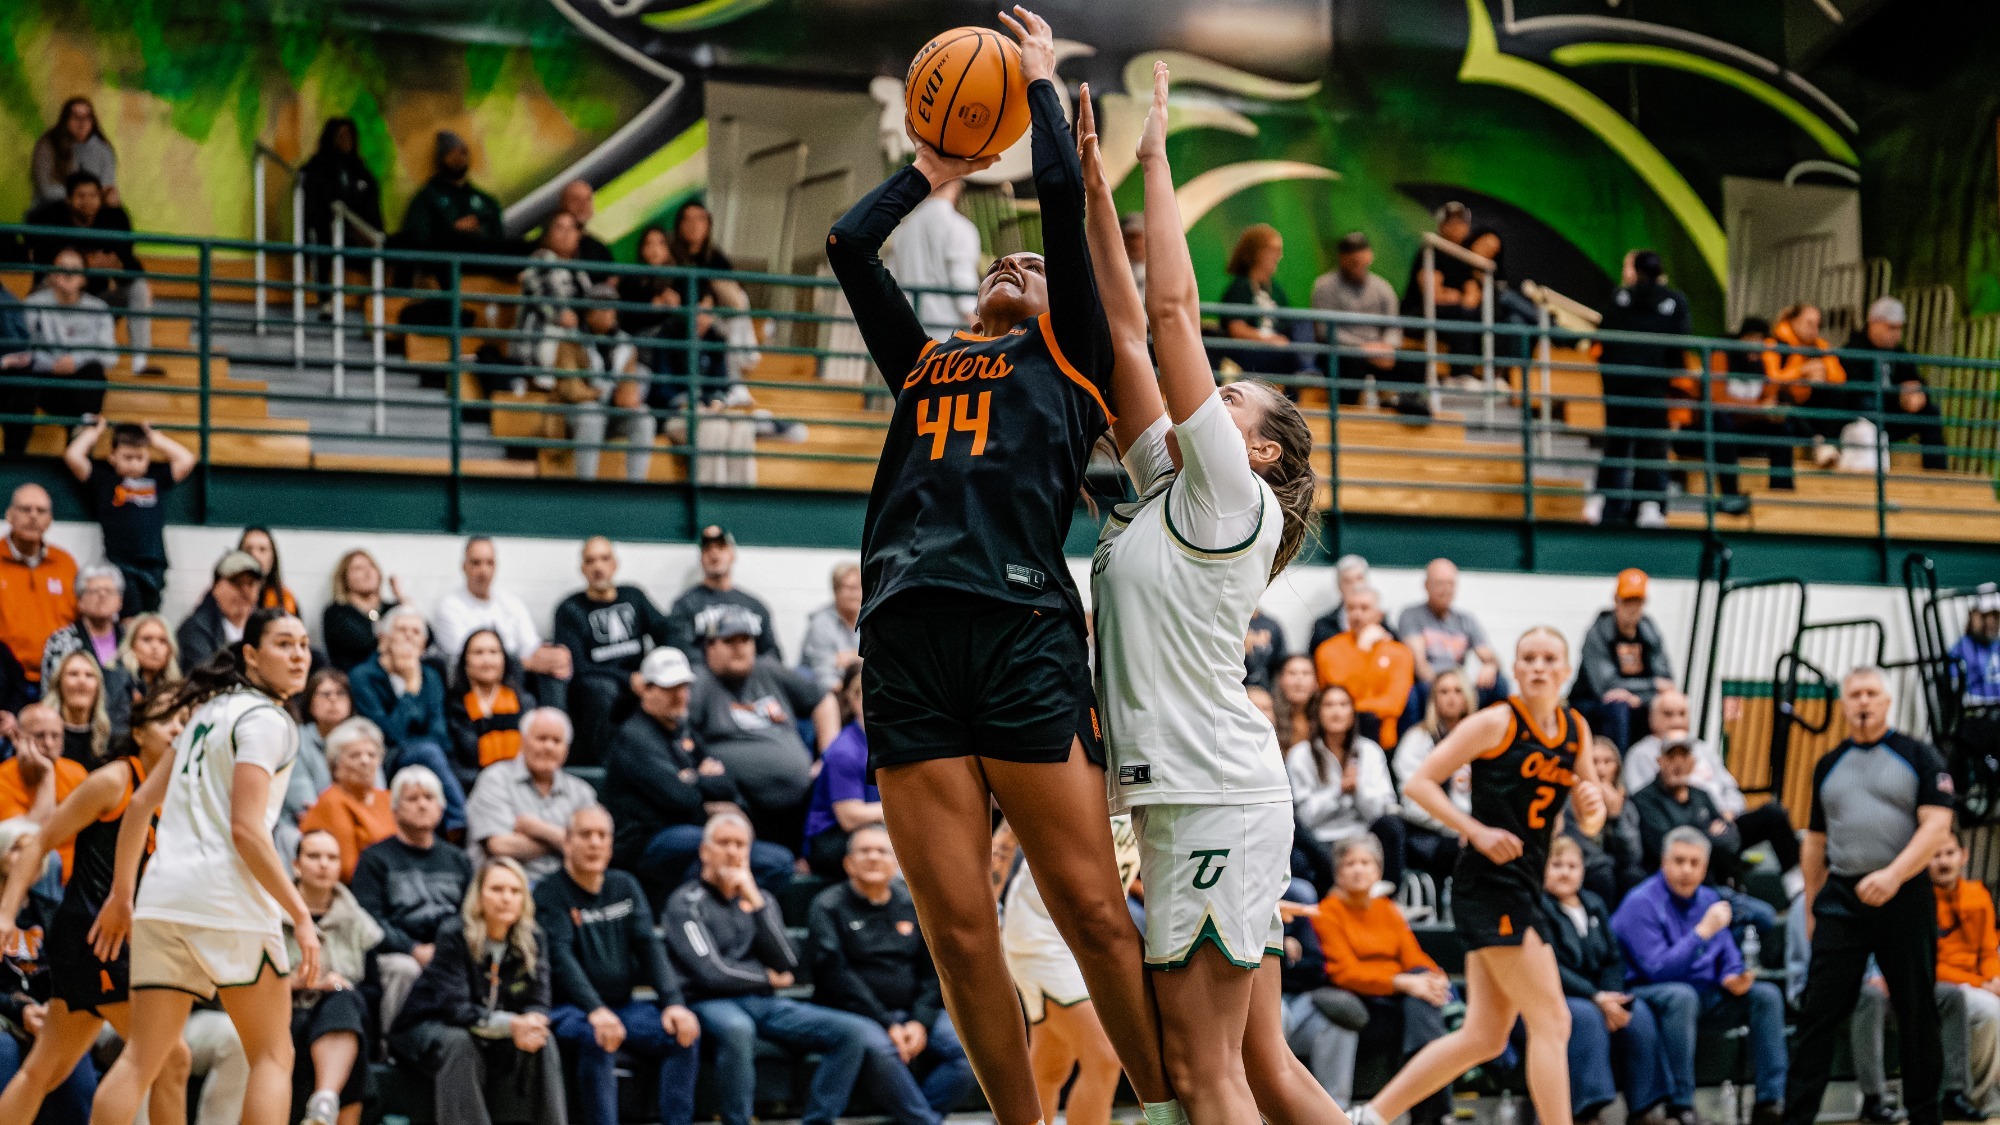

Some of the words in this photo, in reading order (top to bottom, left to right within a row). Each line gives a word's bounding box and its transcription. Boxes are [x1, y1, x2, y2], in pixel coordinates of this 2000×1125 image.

[918, 68, 944, 124] EVO
[916, 390, 993, 461] 44
[1138, 770, 1145, 779] L
[1527, 785, 1557, 830] 2
[1187, 848, 1231, 890] TU
